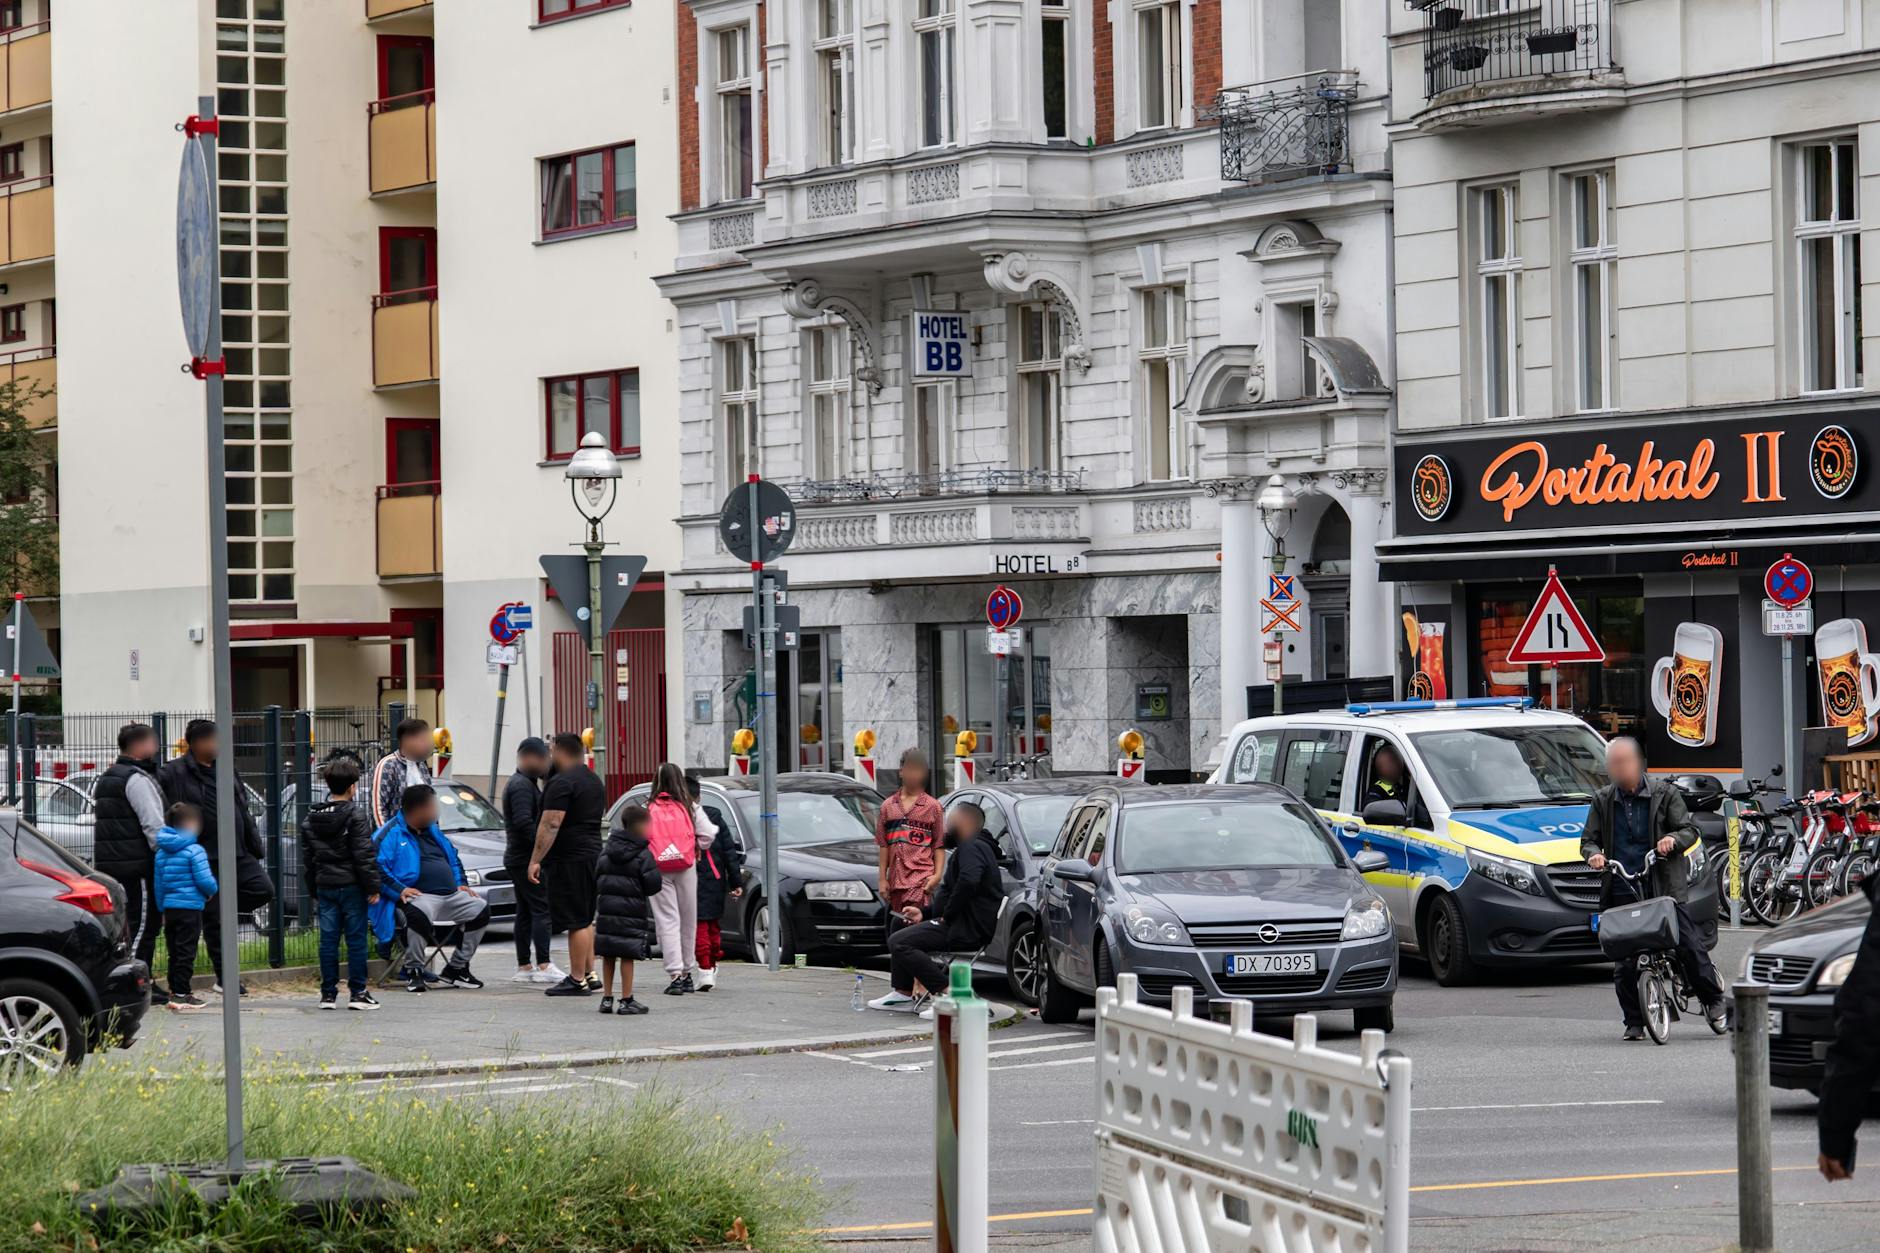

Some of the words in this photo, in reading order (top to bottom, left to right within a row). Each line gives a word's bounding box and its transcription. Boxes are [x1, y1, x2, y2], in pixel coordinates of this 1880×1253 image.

[920, 316, 967, 339] HOTEL
[927, 341, 962, 371] BB
[1480, 438, 1720, 523] Portakal
[1740, 430, 1786, 503] II
[996, 555, 1058, 573] HOTEL
[1682, 552, 1727, 568] Portakal
[1730, 551, 1738, 565] II
[1238, 956, 1257, 972] DX
[1264, 955, 1311, 971] 70395
